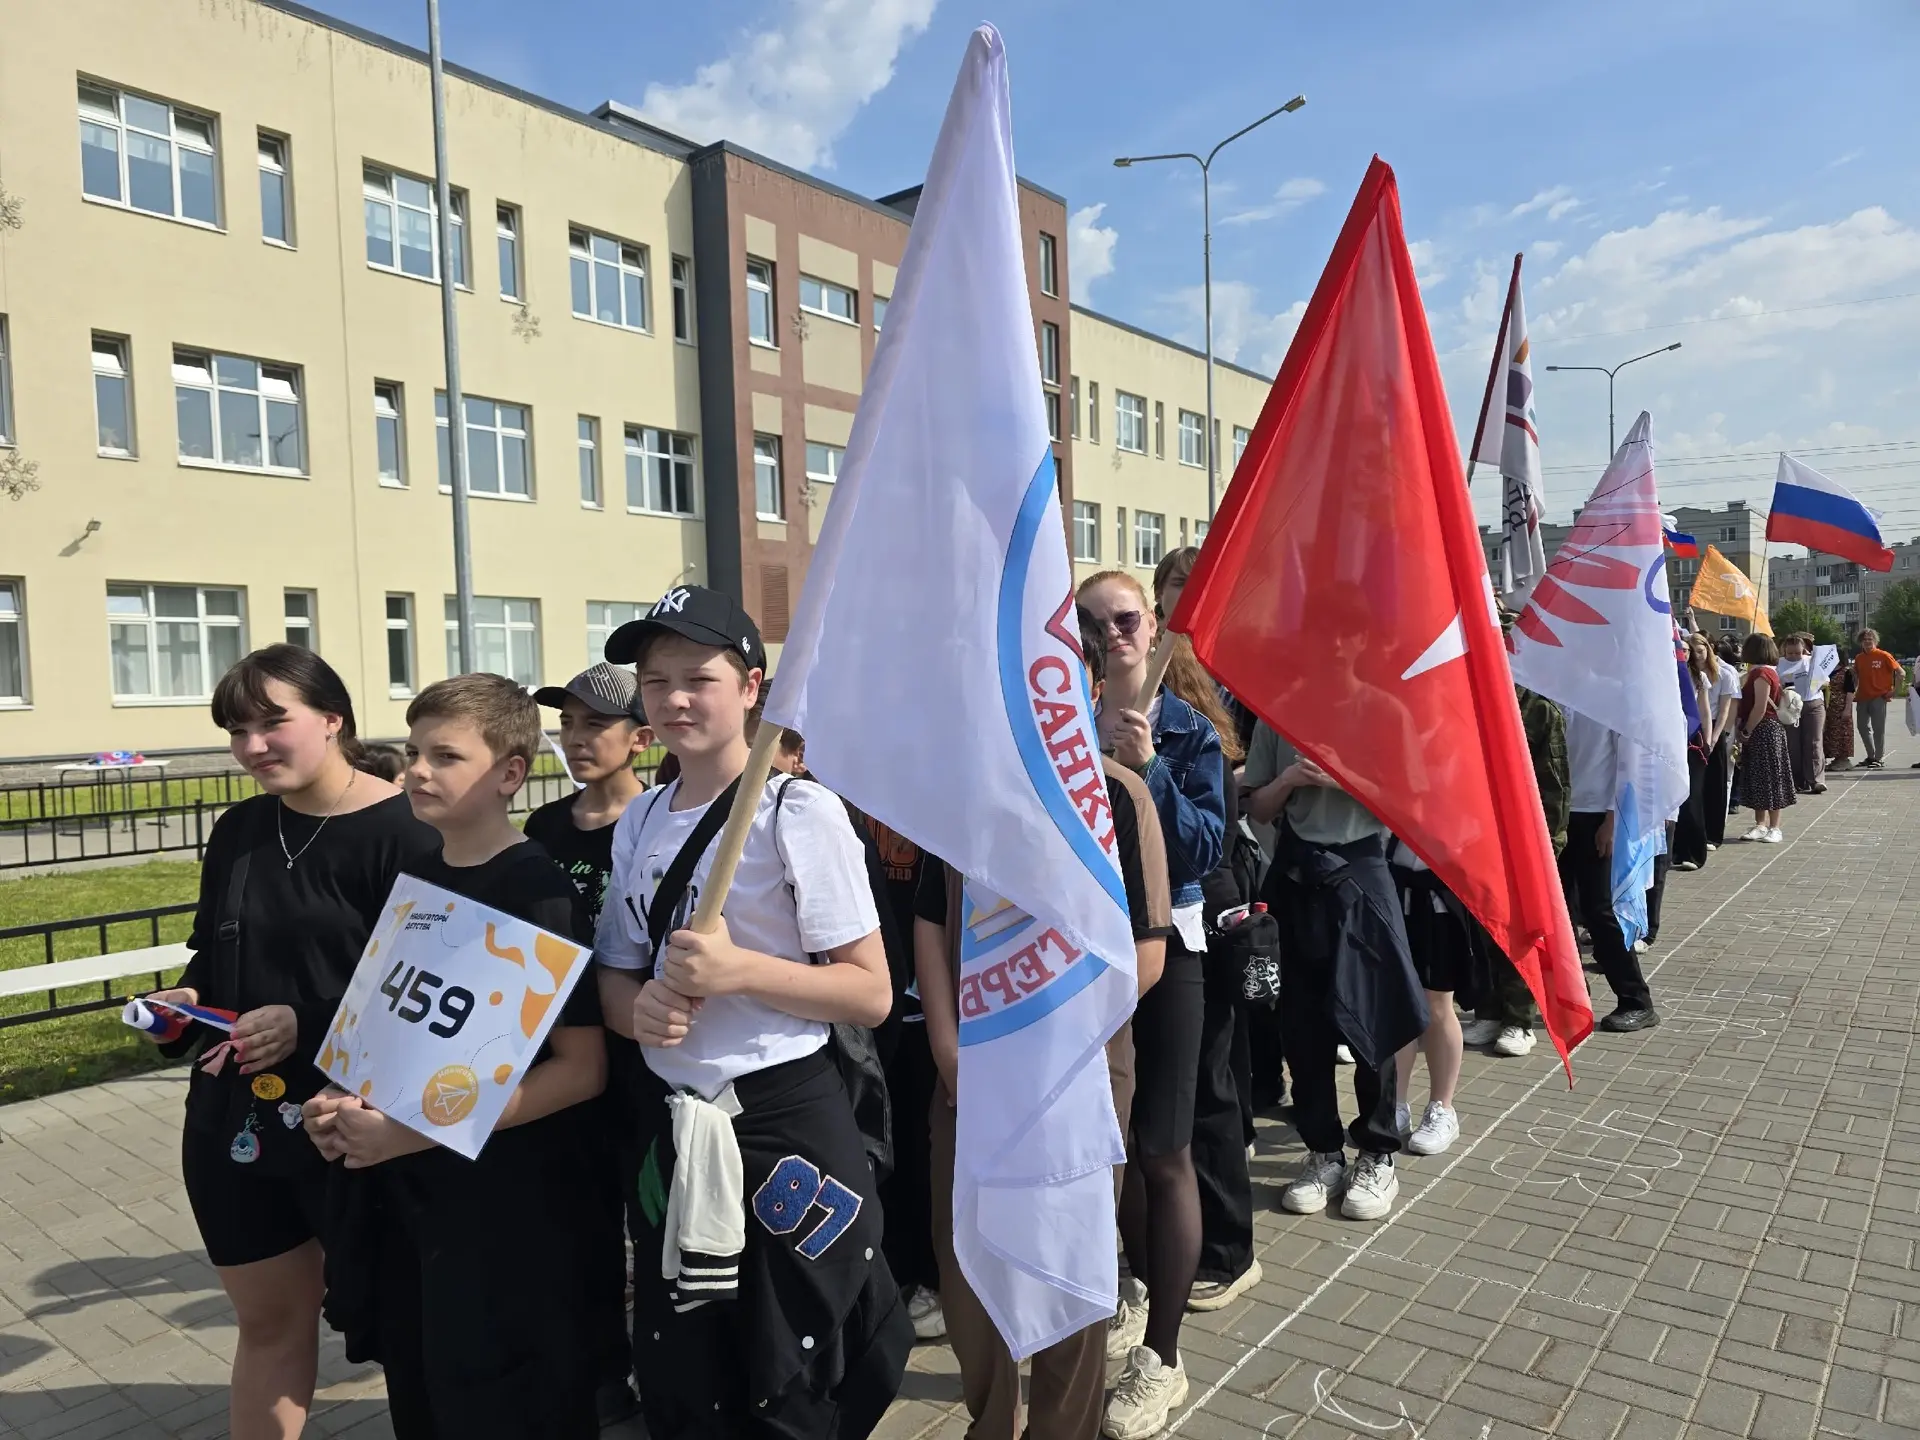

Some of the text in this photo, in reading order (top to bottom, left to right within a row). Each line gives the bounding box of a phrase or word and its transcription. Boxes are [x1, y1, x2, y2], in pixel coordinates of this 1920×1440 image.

[651, 588, 691, 617] NY
[569, 860, 594, 874] in
[884, 866, 912, 881] ARD
[409, 912, 450, 923] НАВИГАТОРЫ
[404, 922, 431, 931] ДЕТСТВА
[380, 960, 475, 1039] 459
[751, 1154, 864, 1261] 87
